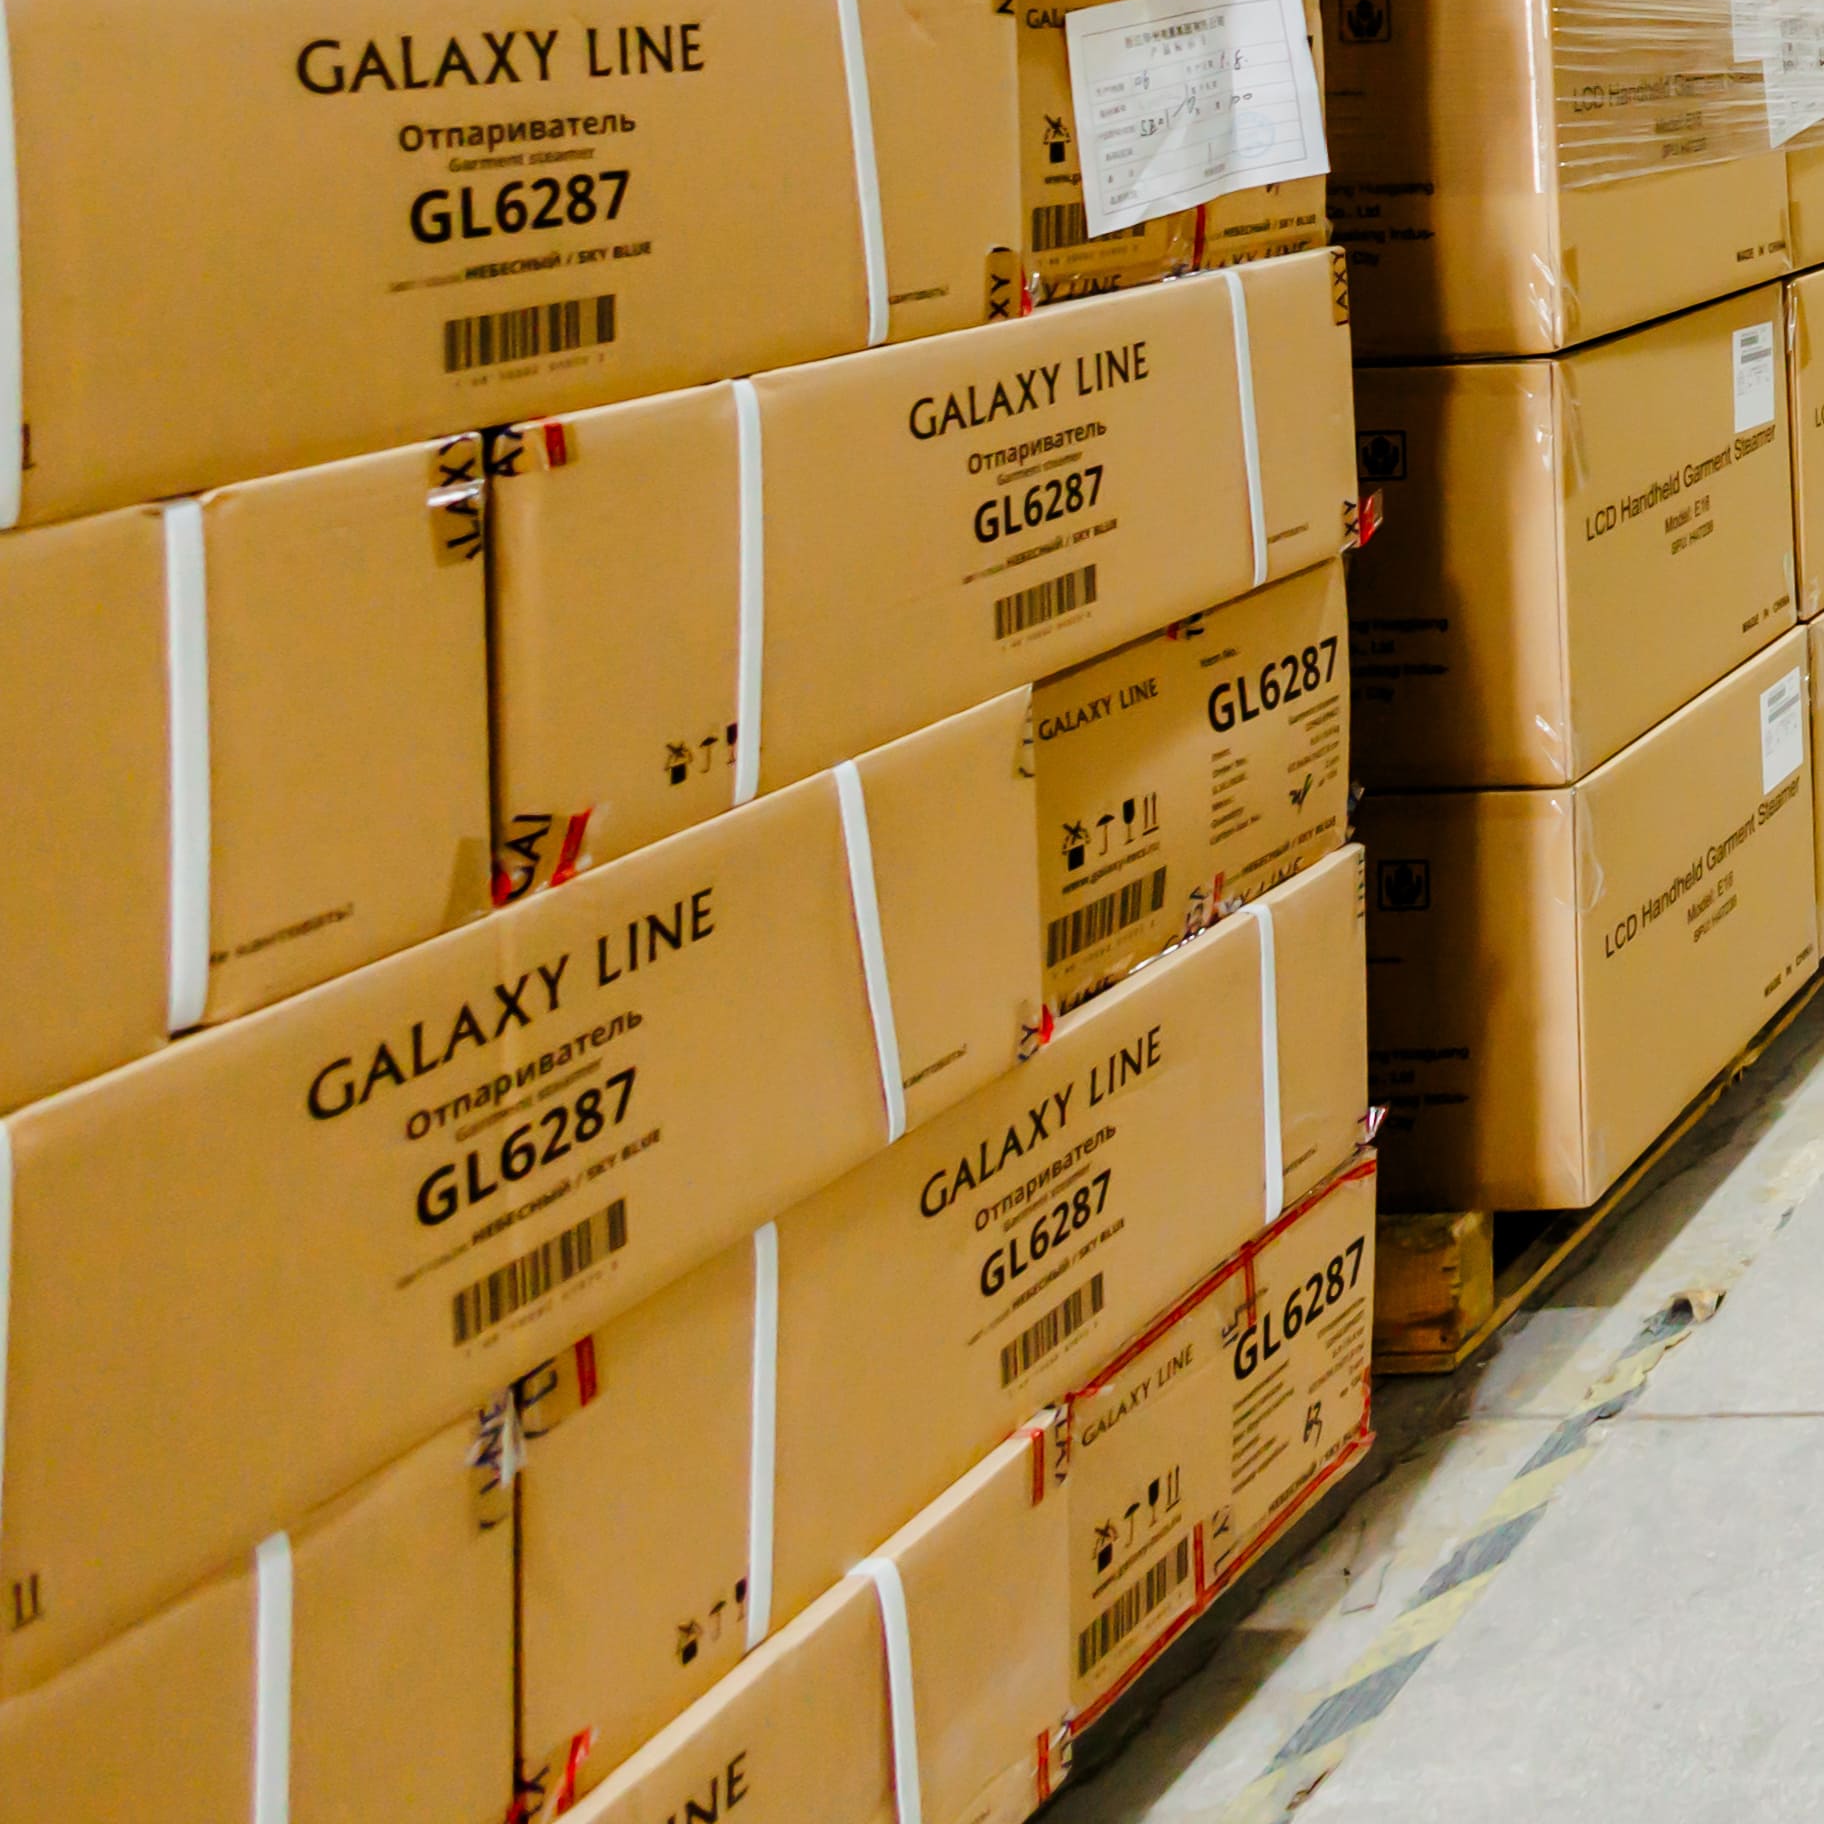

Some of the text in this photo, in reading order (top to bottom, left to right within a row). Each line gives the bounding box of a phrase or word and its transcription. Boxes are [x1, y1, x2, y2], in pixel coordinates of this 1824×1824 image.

[297, 23, 705, 94] GALAXY LINE
[399, 112, 636, 153] Отпариватель
[410, 170, 631, 243] GL6287
[909, 341, 1149, 440] GALAXY LINE
[967, 421, 1107, 474] Отпариватель
[975, 465, 1104, 544] GL6287
[1586, 505, 1617, 541] LCD
[1039, 678, 1158, 741] GALAXY LINE
[1208, 636, 1340, 733] GL6287
[1605, 914, 1638, 959] LCD
[308, 888, 715, 1120] GALAXY LINE
[406, 1009, 643, 1141] Отпариватель
[920, 1025, 1162, 1218] GALAXY LINE
[416, 1066, 637, 1227] GL6287
[974, 1124, 1116, 1231] Отпариватель
[980, 1168, 1111, 1296] GL6287
[1233, 1236, 1365, 1380] GL6287
